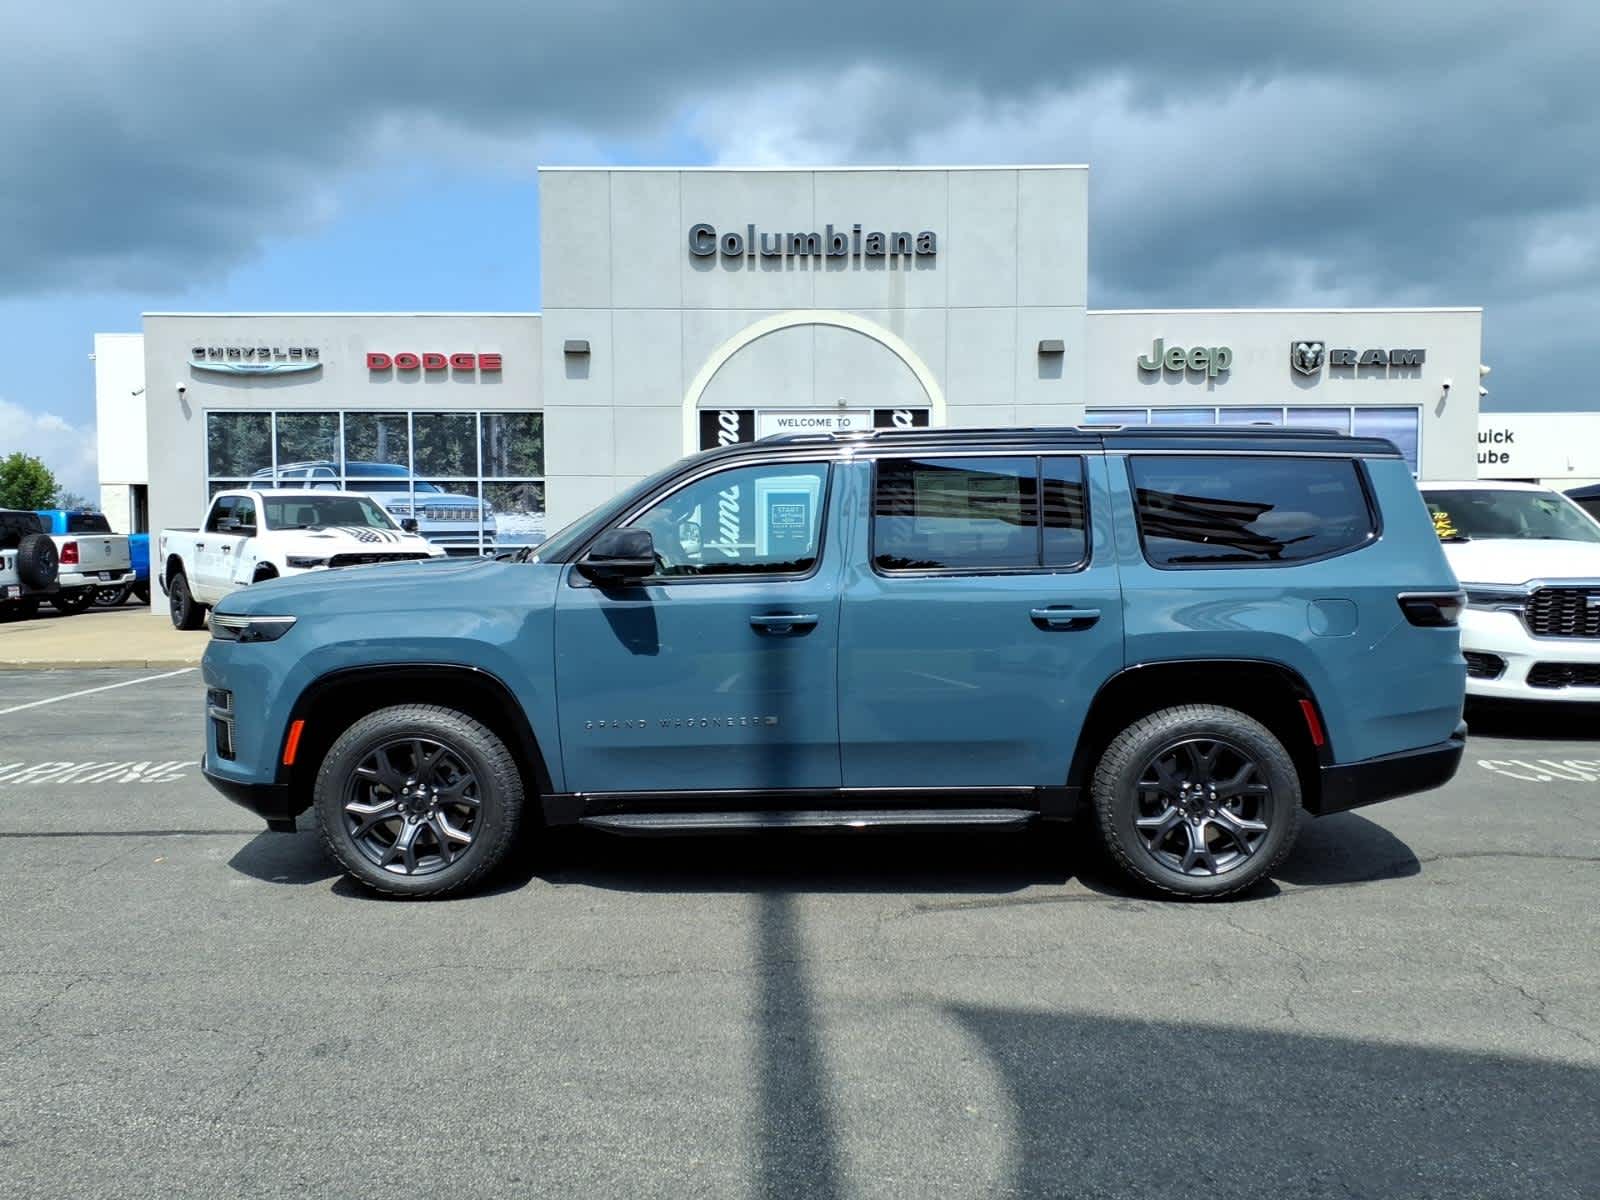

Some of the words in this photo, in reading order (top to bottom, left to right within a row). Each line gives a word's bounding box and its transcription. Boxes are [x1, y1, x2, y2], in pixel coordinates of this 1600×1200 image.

[688, 223, 937, 256] Columbiana
[191, 346, 320, 359] CHRYSLER
[366, 352, 503, 369] DODGE
[1137, 338, 1233, 377] Jeep
[1329, 349, 1427, 368] RAM
[777, 418, 832, 428] WELCOME
[835, 418, 851, 428] TO
[583, 719, 648, 730] GRAND
[657, 715, 761, 730] WAGONEER
[0, 761, 200, 784] RKING
